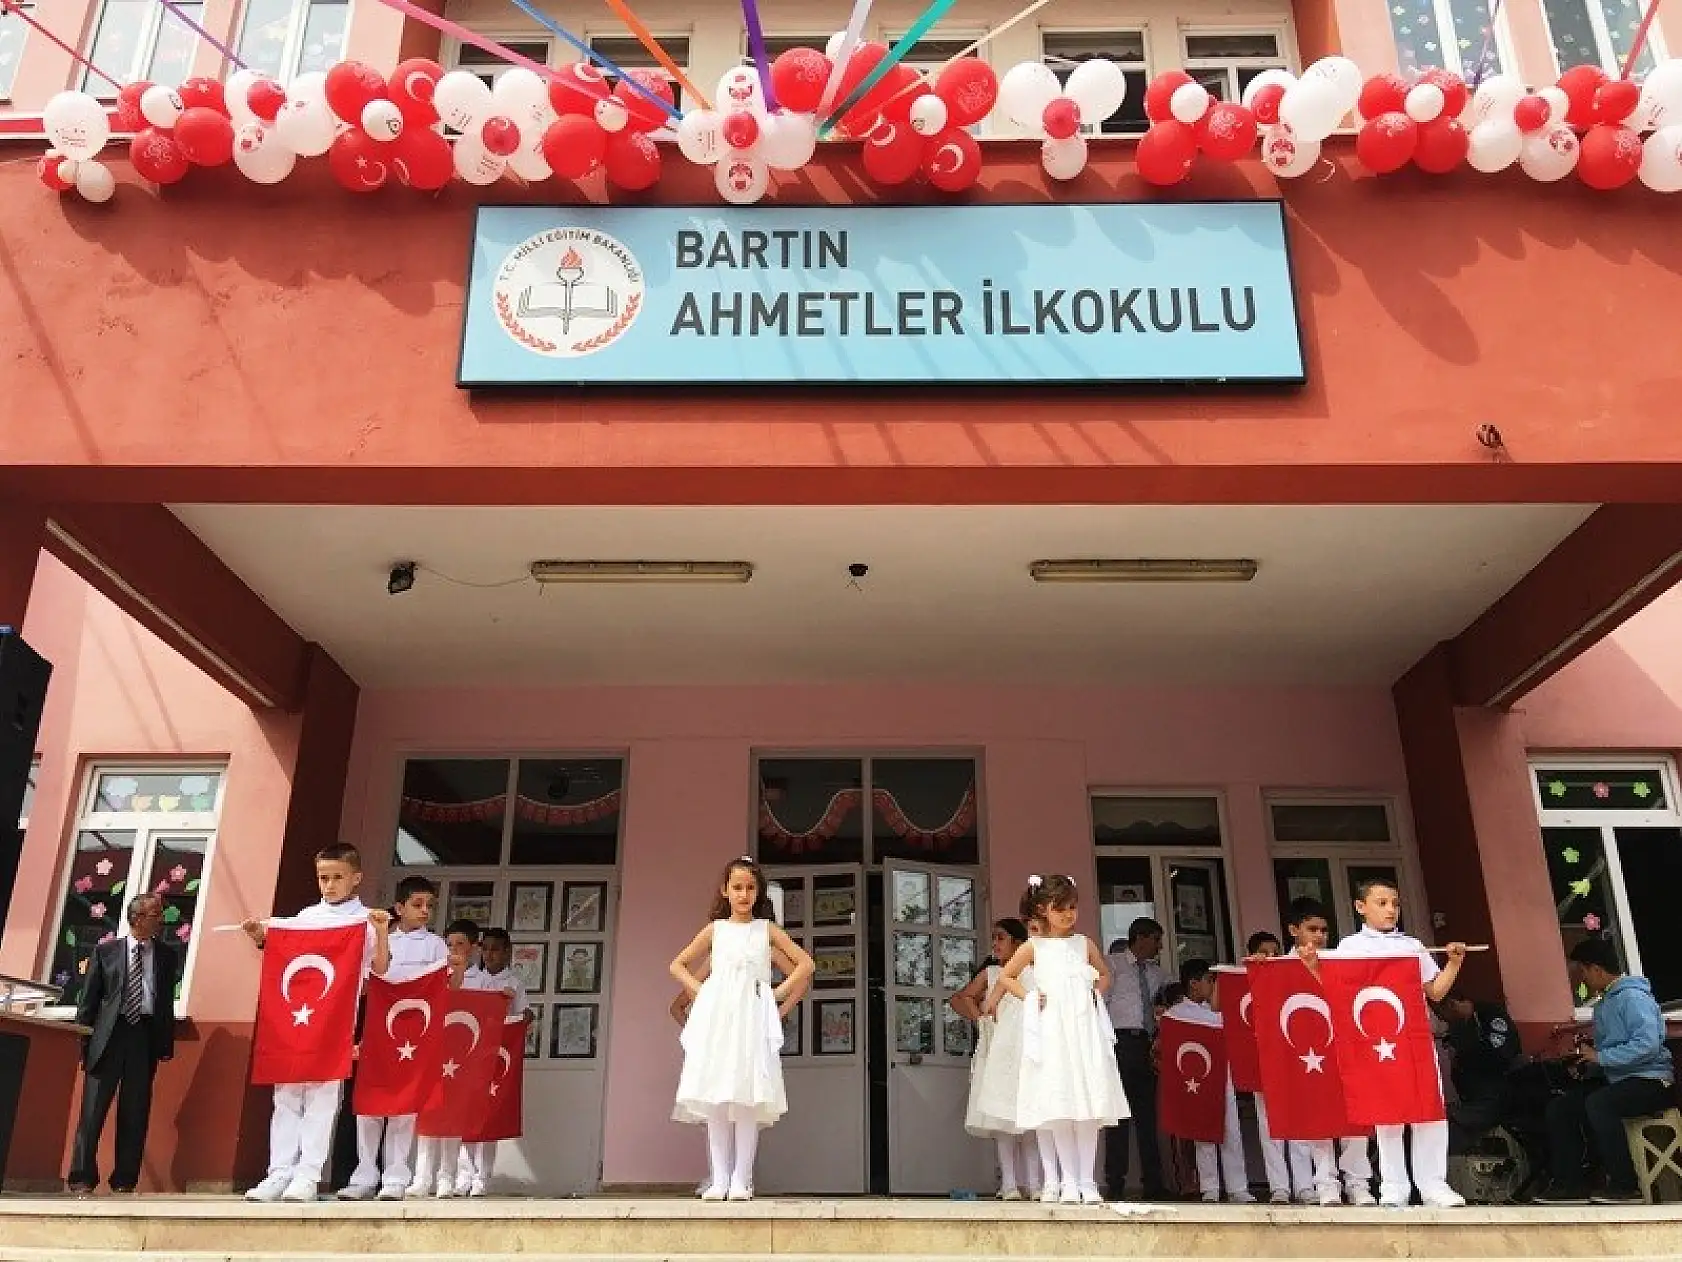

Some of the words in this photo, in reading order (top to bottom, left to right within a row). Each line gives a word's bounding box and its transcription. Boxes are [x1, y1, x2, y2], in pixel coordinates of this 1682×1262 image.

[676, 230, 848, 268] BARTIN
[669, 290, 965, 337] AHMETLER
[983, 279, 1256, 335] İLKOKULU
